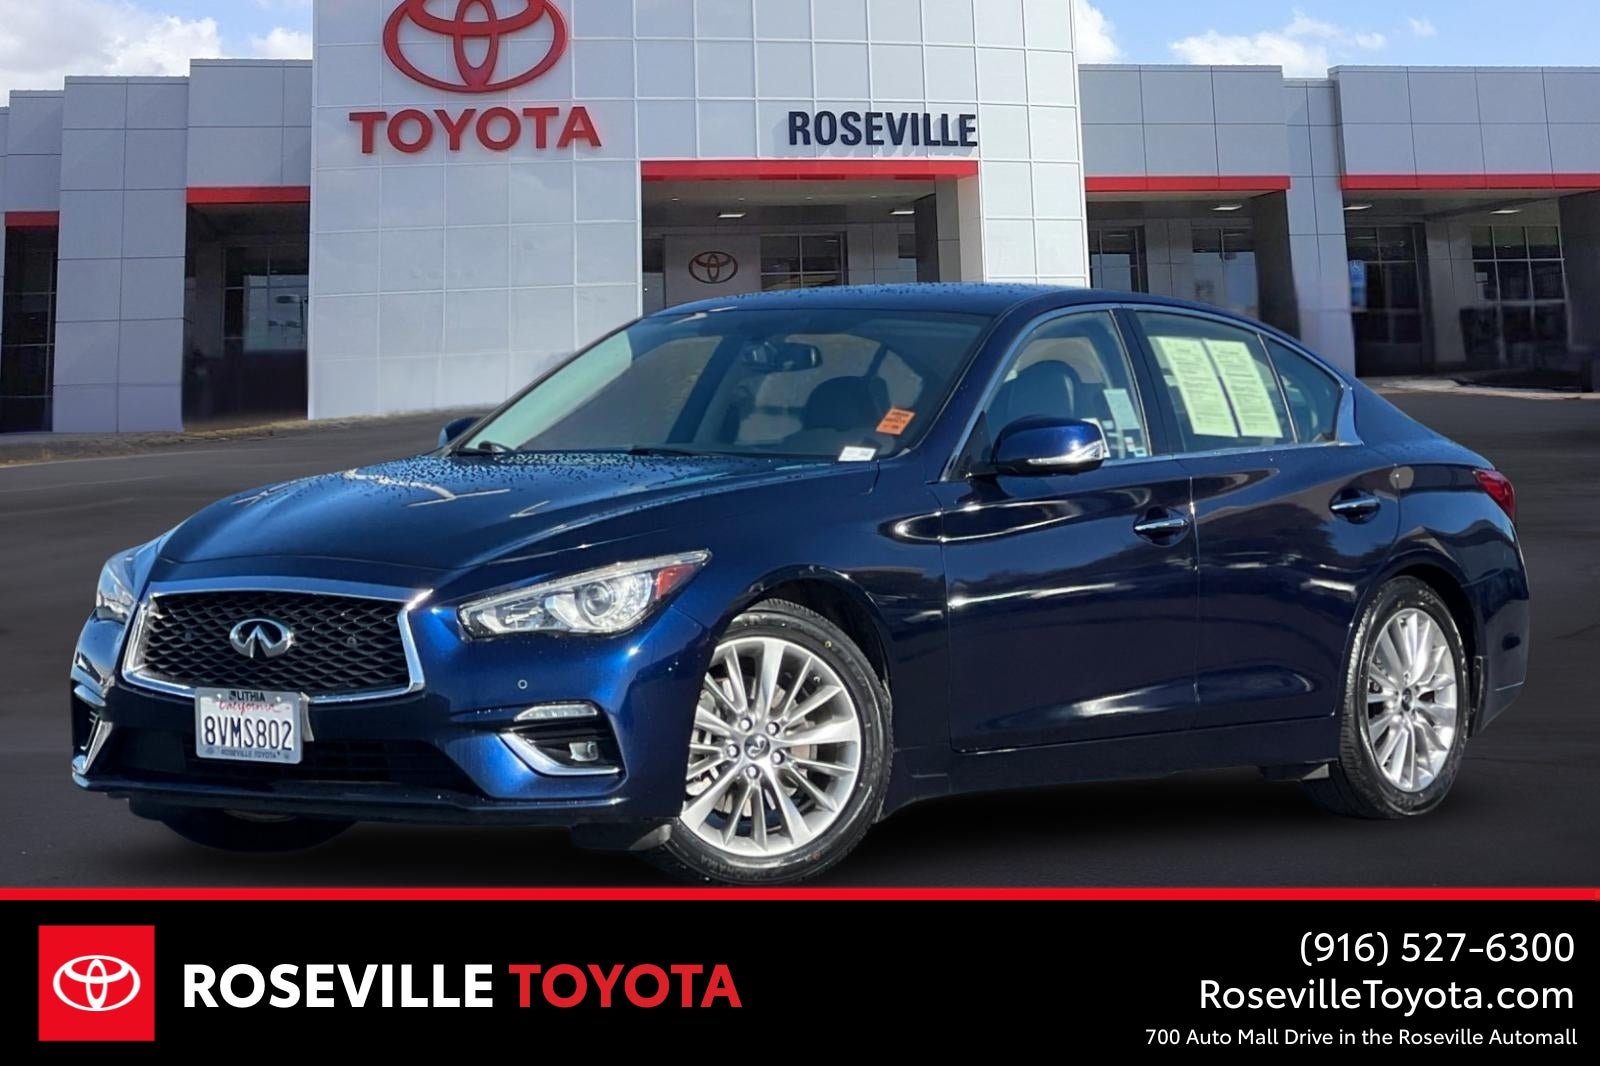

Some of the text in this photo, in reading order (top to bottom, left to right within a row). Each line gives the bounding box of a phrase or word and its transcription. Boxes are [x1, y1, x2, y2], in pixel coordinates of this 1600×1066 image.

[349, 107, 602, 155] TOYOTA
[788, 110, 978, 148] ROSEVILLE
[236, 690, 266, 703] LITHIA
[204, 715, 292, 751] 8VMS802
[221, 747, 277, 759] ROSEVILLE TOYOTA
